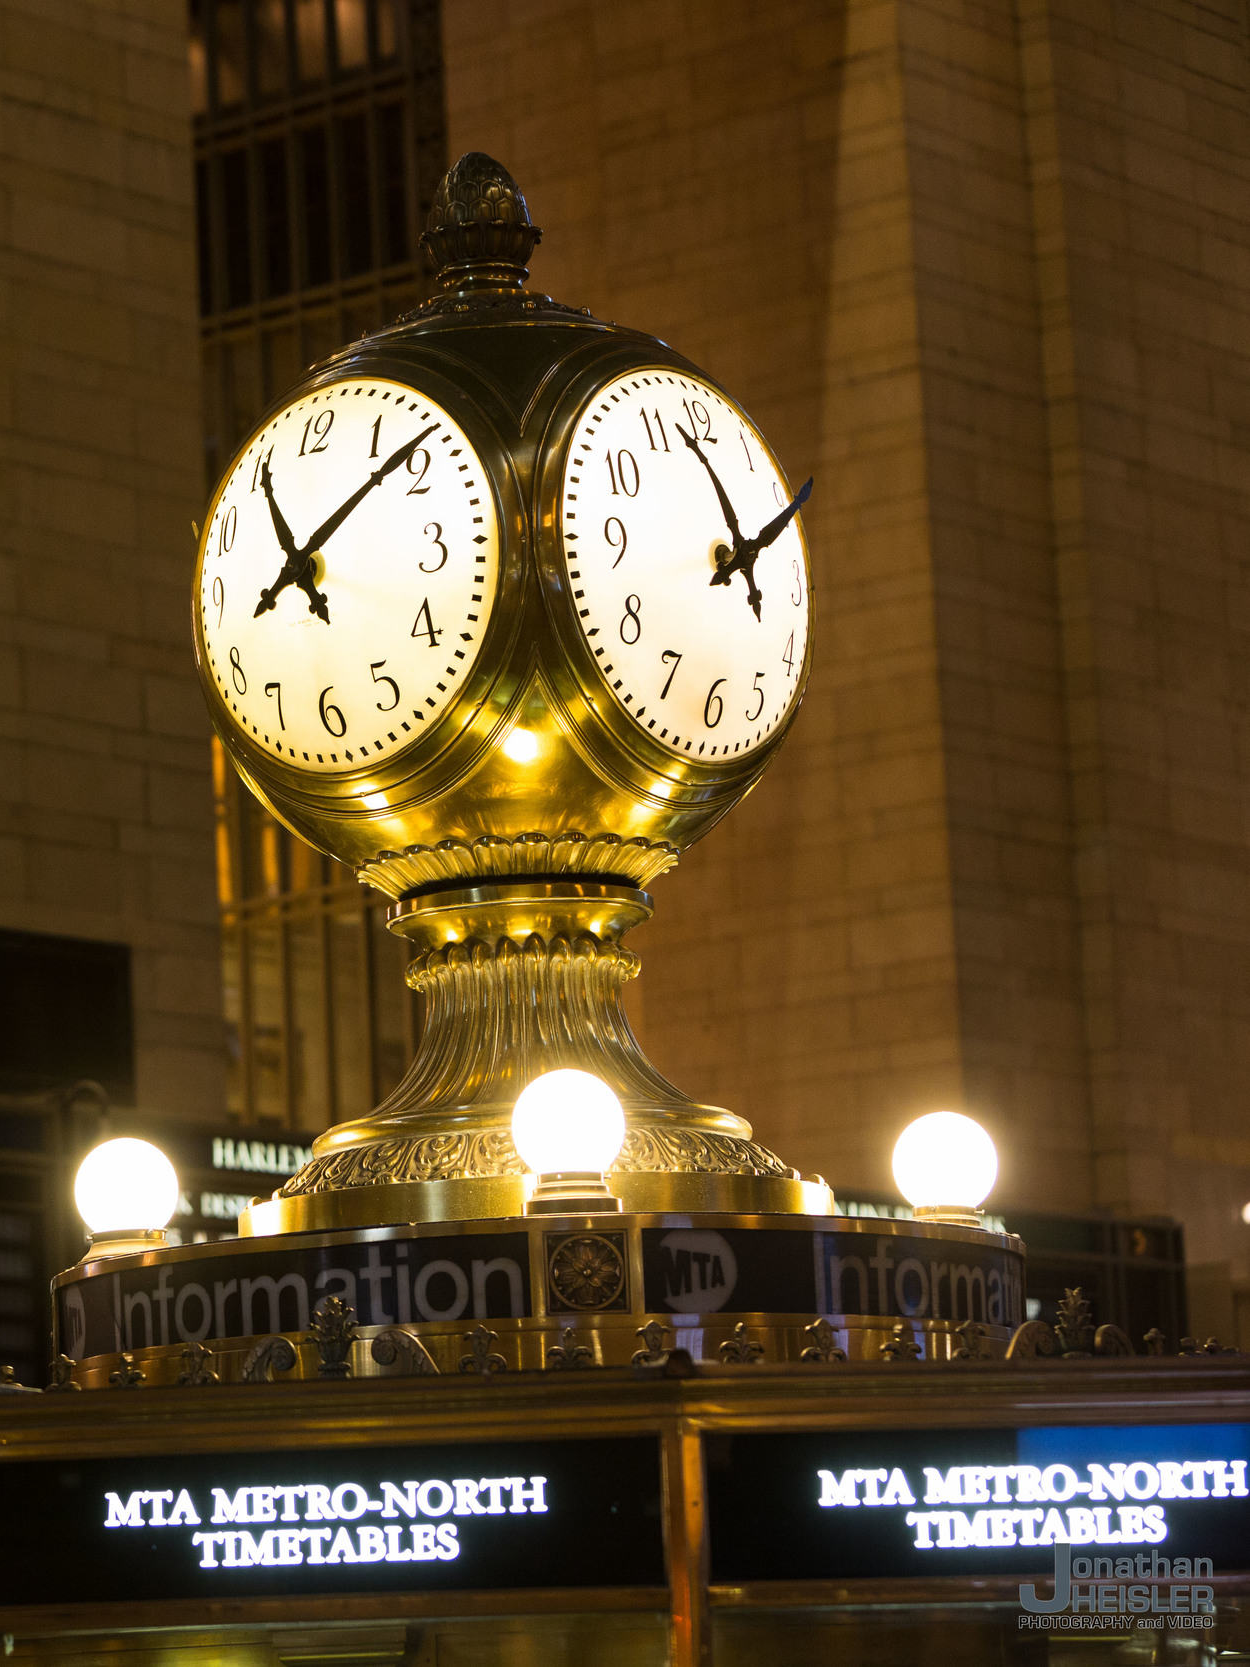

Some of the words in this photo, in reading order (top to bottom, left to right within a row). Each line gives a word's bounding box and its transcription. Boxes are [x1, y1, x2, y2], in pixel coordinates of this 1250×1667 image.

[298, 409, 335, 457] 12
[368, 414, 382, 459] 1
[639, 407, 671, 452] 11
[682, 397, 718, 444] 12
[406, 448, 431, 496] 2
[605, 448, 640, 497] 10
[739, 429, 755, 472] 1
[218, 505, 237, 557] 10
[418, 522, 448, 573] 3
[604, 517, 627, 569] 9
[212, 576, 225, 629] 9
[791, 559, 802, 607] 3
[410, 597, 444, 648] 4
[620, 594, 641, 645] 8
[229, 646, 247, 695] 8
[661, 650, 683, 700] 7
[782, 629, 795, 677] 4
[264, 682, 286, 731] 7
[370, 659, 401, 711] 5
[704, 678, 728, 729] 6
[745, 671, 766, 721] 5
[318, 685, 347, 738] 6
[660, 1245, 726, 1297] MTA
[113, 1243, 526, 1353] Information
[104, 1488, 201, 1528] MTA
[211, 1476, 548, 1523] METRO-NORTH
[818, 1467, 916, 1507] MTA
[923, 1460, 1249, 1505] METRO-NORTH
[192, 1523, 460, 1568] TIMETABLES
[906, 1505, 1168, 1549] TIMETABLES
